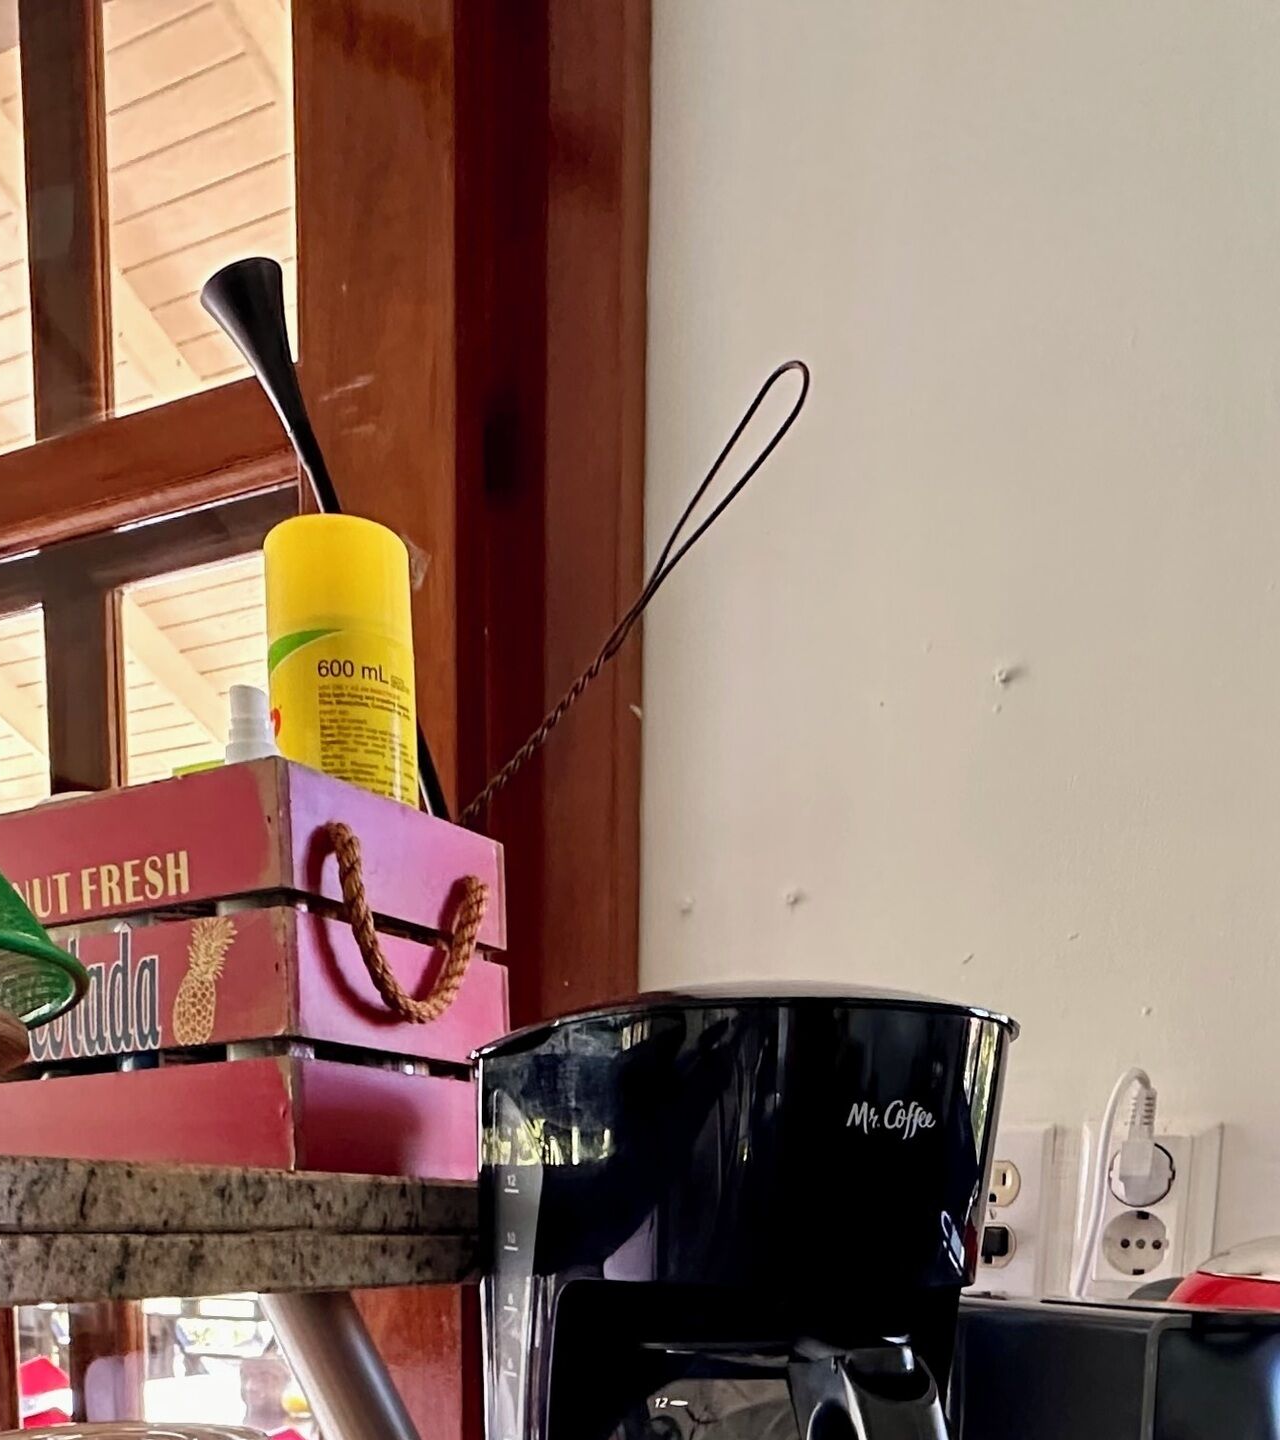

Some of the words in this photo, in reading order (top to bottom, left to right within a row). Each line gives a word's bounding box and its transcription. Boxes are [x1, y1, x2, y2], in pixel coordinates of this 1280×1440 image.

[317, 659, 355, 678] 600
[361, 664, 389, 684] mL
[80, 850, 190, 911] FRESH
[846, 1101, 880, 1135] Mr.
[883, 1099, 937, 1140] Coffee
[506, 1173, 517, 1187] 12
[655, 1397, 669, 1409] 12
